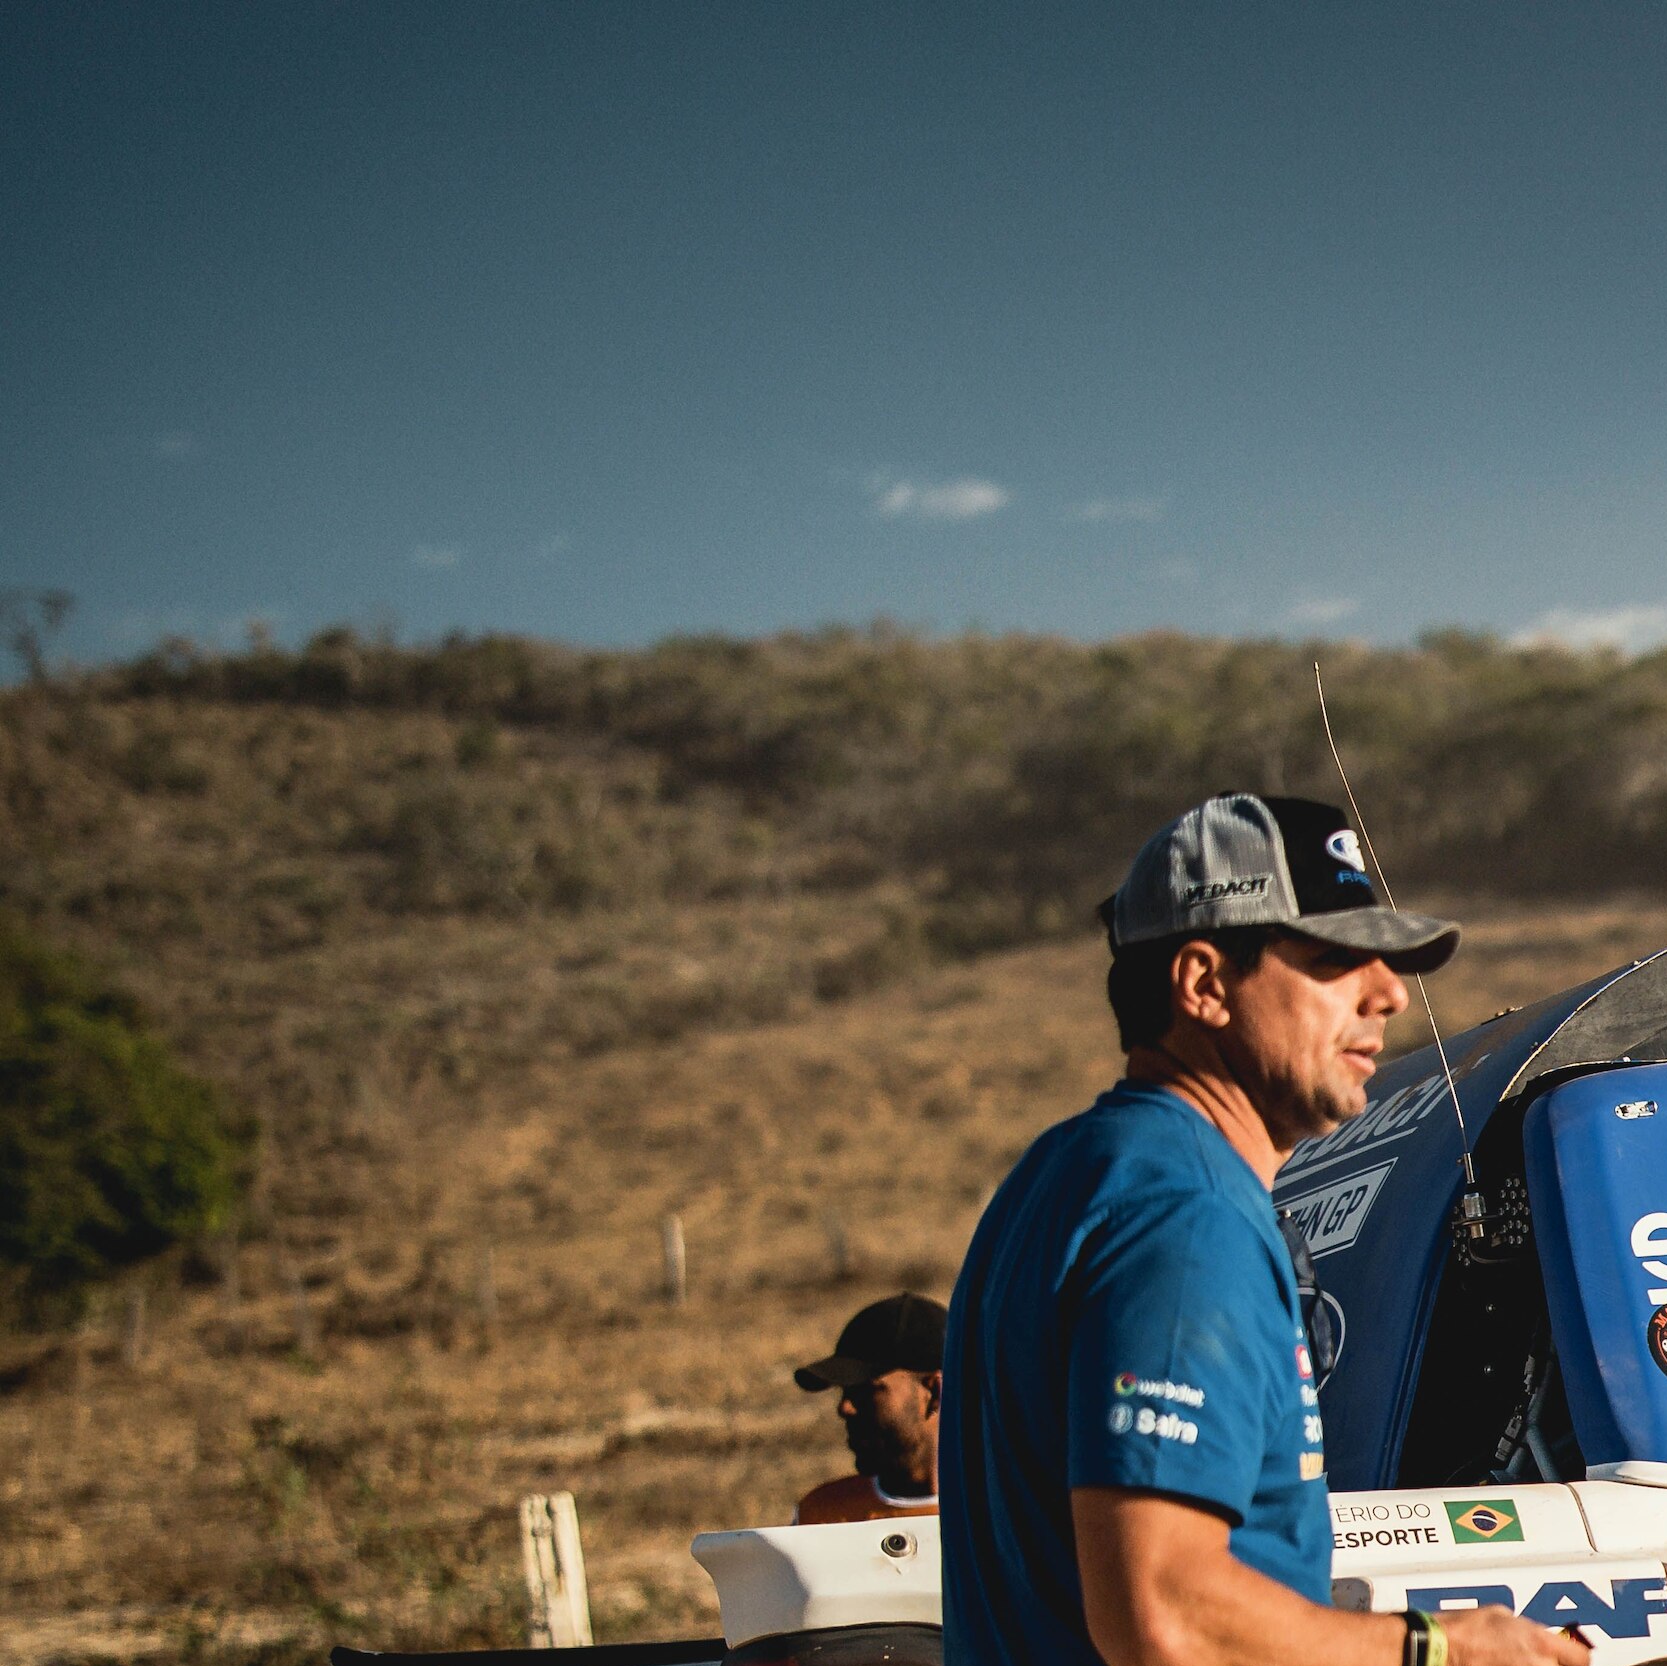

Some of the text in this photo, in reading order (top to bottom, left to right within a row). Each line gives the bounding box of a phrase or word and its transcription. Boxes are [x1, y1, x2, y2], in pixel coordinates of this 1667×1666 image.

[1136, 1407, 1199, 1445] Safra
[1396, 1503, 1432, 1519] DO
[1333, 1527, 1440, 1550] ESPORTE
